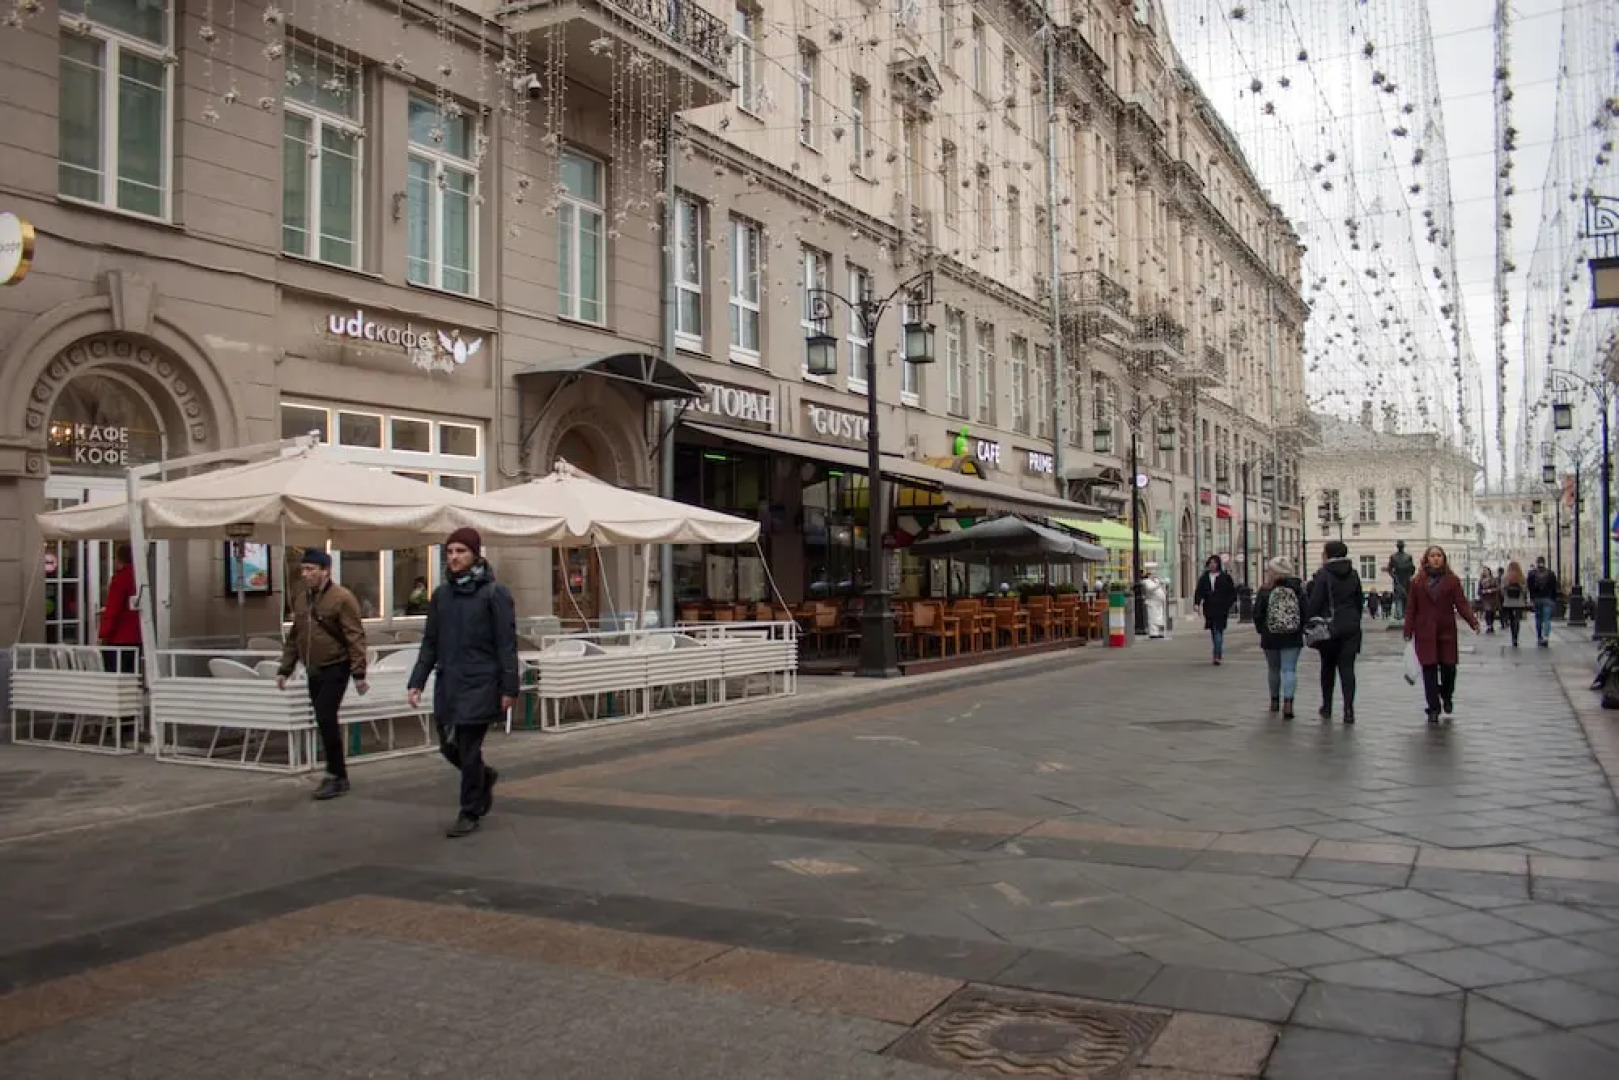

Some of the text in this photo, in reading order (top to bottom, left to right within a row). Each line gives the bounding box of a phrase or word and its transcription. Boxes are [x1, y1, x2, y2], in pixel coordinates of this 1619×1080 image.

[672, 383, 775, 423] СТОРАН
[75, 423, 129, 443] КАФЕ
[75, 447, 129, 465] КОФЕ
[977, 440, 1000, 464] CAFE
[1028, 451, 1053, 474] PRIME
